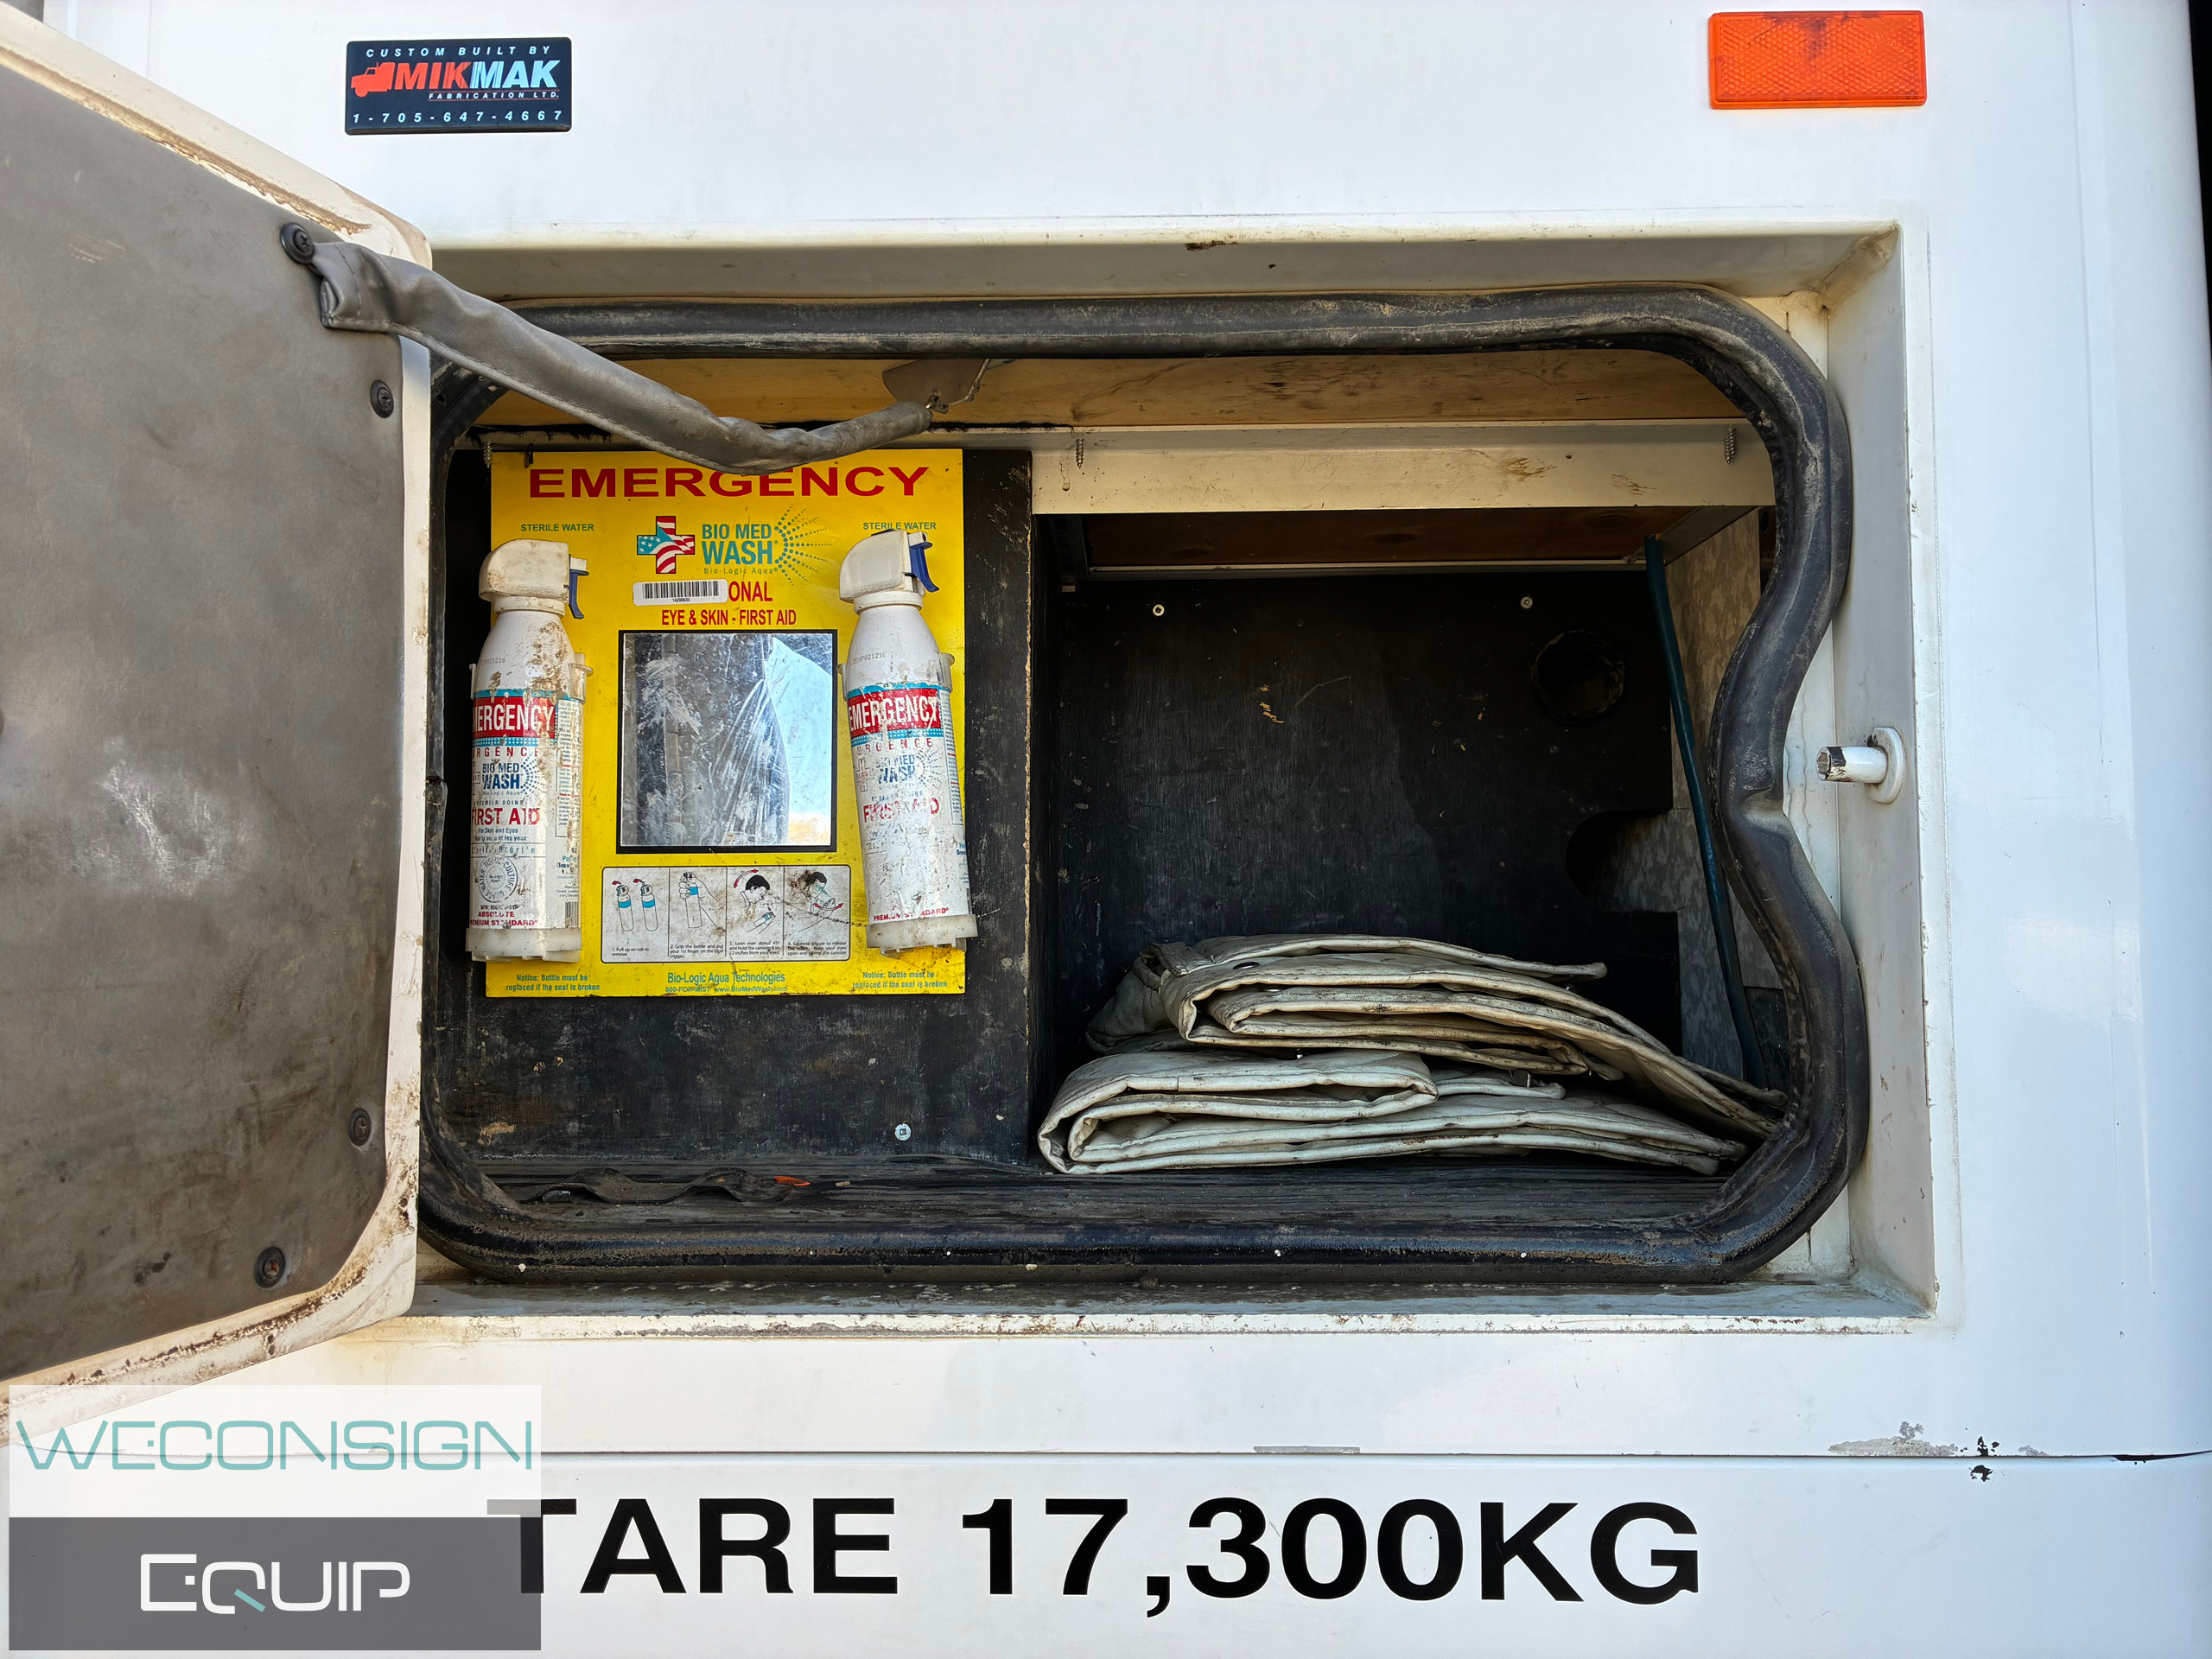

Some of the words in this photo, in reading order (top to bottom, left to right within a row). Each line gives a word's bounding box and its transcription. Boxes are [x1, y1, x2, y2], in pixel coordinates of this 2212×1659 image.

[365, 47, 446, 58] CUSTOM
[458, 46, 517, 56] BUILT
[528, 46, 550, 55] BY
[394, 60, 561, 90] MIKMAK
[429, 92, 524, 100] FABRICATION
[353, 110, 563, 124] 1-705-647-4667
[530, 466, 930, 498] EMERGENCY
[562, 523, 594, 531] WATER
[702, 524, 730, 540] BIO
[735, 524, 772, 540] MED
[862, 522, 901, 531] STERILE
[701, 540, 772, 565] WASH
[703, 567, 747, 575] Bio-Logic
[752, 567, 774, 575] Aqua
[661, 609, 686, 626] EYE
[689, 609, 697, 626] &
[700, 609, 728, 626] SKIN
[739, 609, 774, 626] FIRST
[776, 609, 797, 626] AID
[849, 695, 938, 731] EMERGENCY
[498, 762, 520, 773] MED
[482, 773, 520, 790] WASH
[509, 807, 540, 825] AID
[667, 971, 707, 985] Bio-Logic
[732, 970, 785, 985] Technologies
[853, 981, 881, 989] replaced
[506, 983, 535, 992] replaced
[486, 1497, 898, 1594] TARE
[962, 1497, 1700, 1618] 17,300KG
